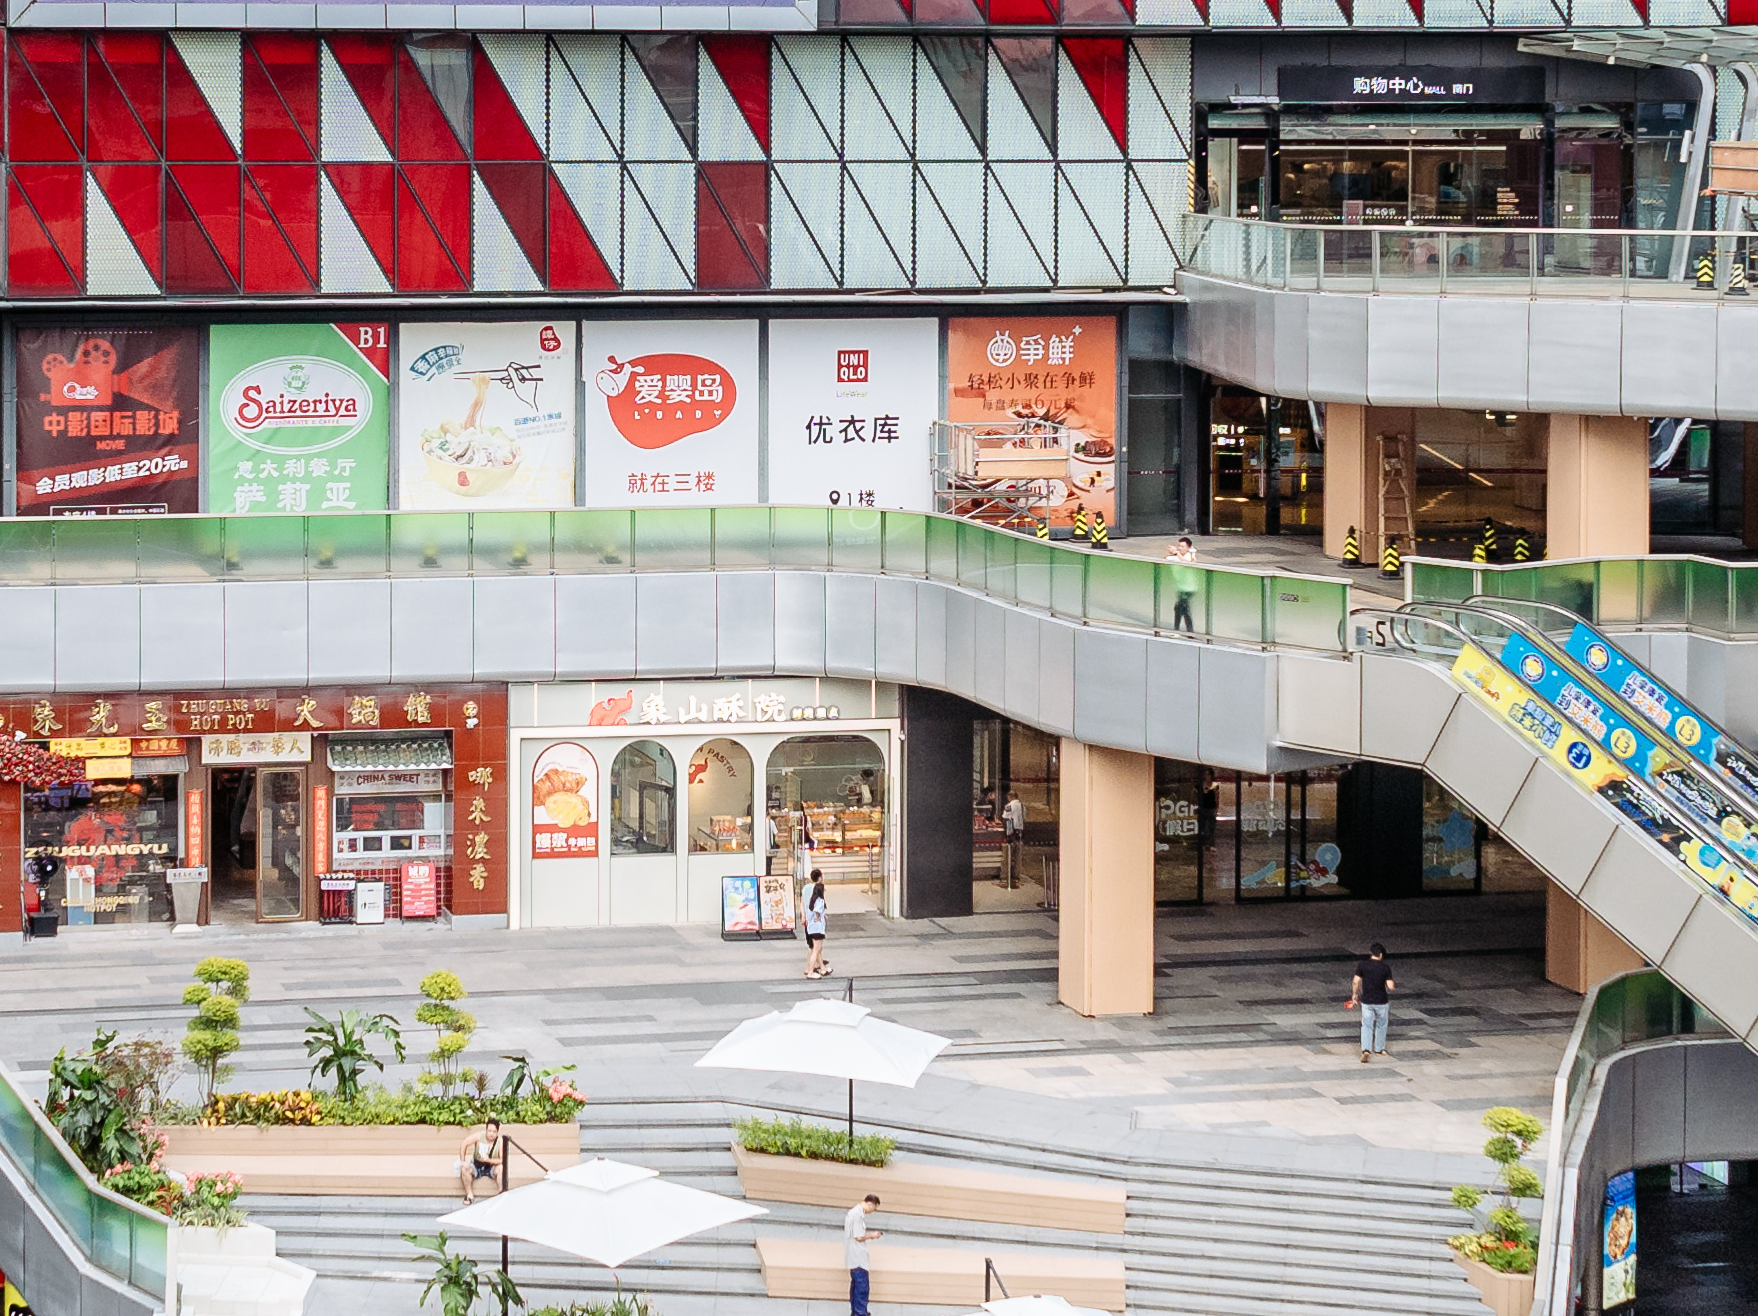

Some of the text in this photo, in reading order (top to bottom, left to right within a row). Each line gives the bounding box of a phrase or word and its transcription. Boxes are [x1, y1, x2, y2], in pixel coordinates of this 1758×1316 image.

[1353, 76, 1424, 95] 购物中心
[357, 326, 389, 350] B1
[840, 353, 865, 366] UNI
[840, 367, 866, 381] QLO
[967, 371, 1096, 391] 轻松小聚在争鲜
[634, 374, 723, 404] 爱婴岛
[234, 385, 359, 430] Saizeriya
[43, 409, 181, 438] 中影国际影城
[805, 414, 901, 445] 优衣库
[95, 440, 126, 451] MOVIE
[233, 457, 358, 480] 意大利餐厅
[627, 472, 717, 494] 就在三楼
[234, 481, 358, 514] 萨莉亚
[180, 699, 249, 713] ZHUGUANG
[639, 691, 788, 726] 象山酥院
[189, 713, 256, 731] HOT POT
[704, 745, 738, 780] PASTRY
[356, 772, 421, 786] CHINA SWEET
